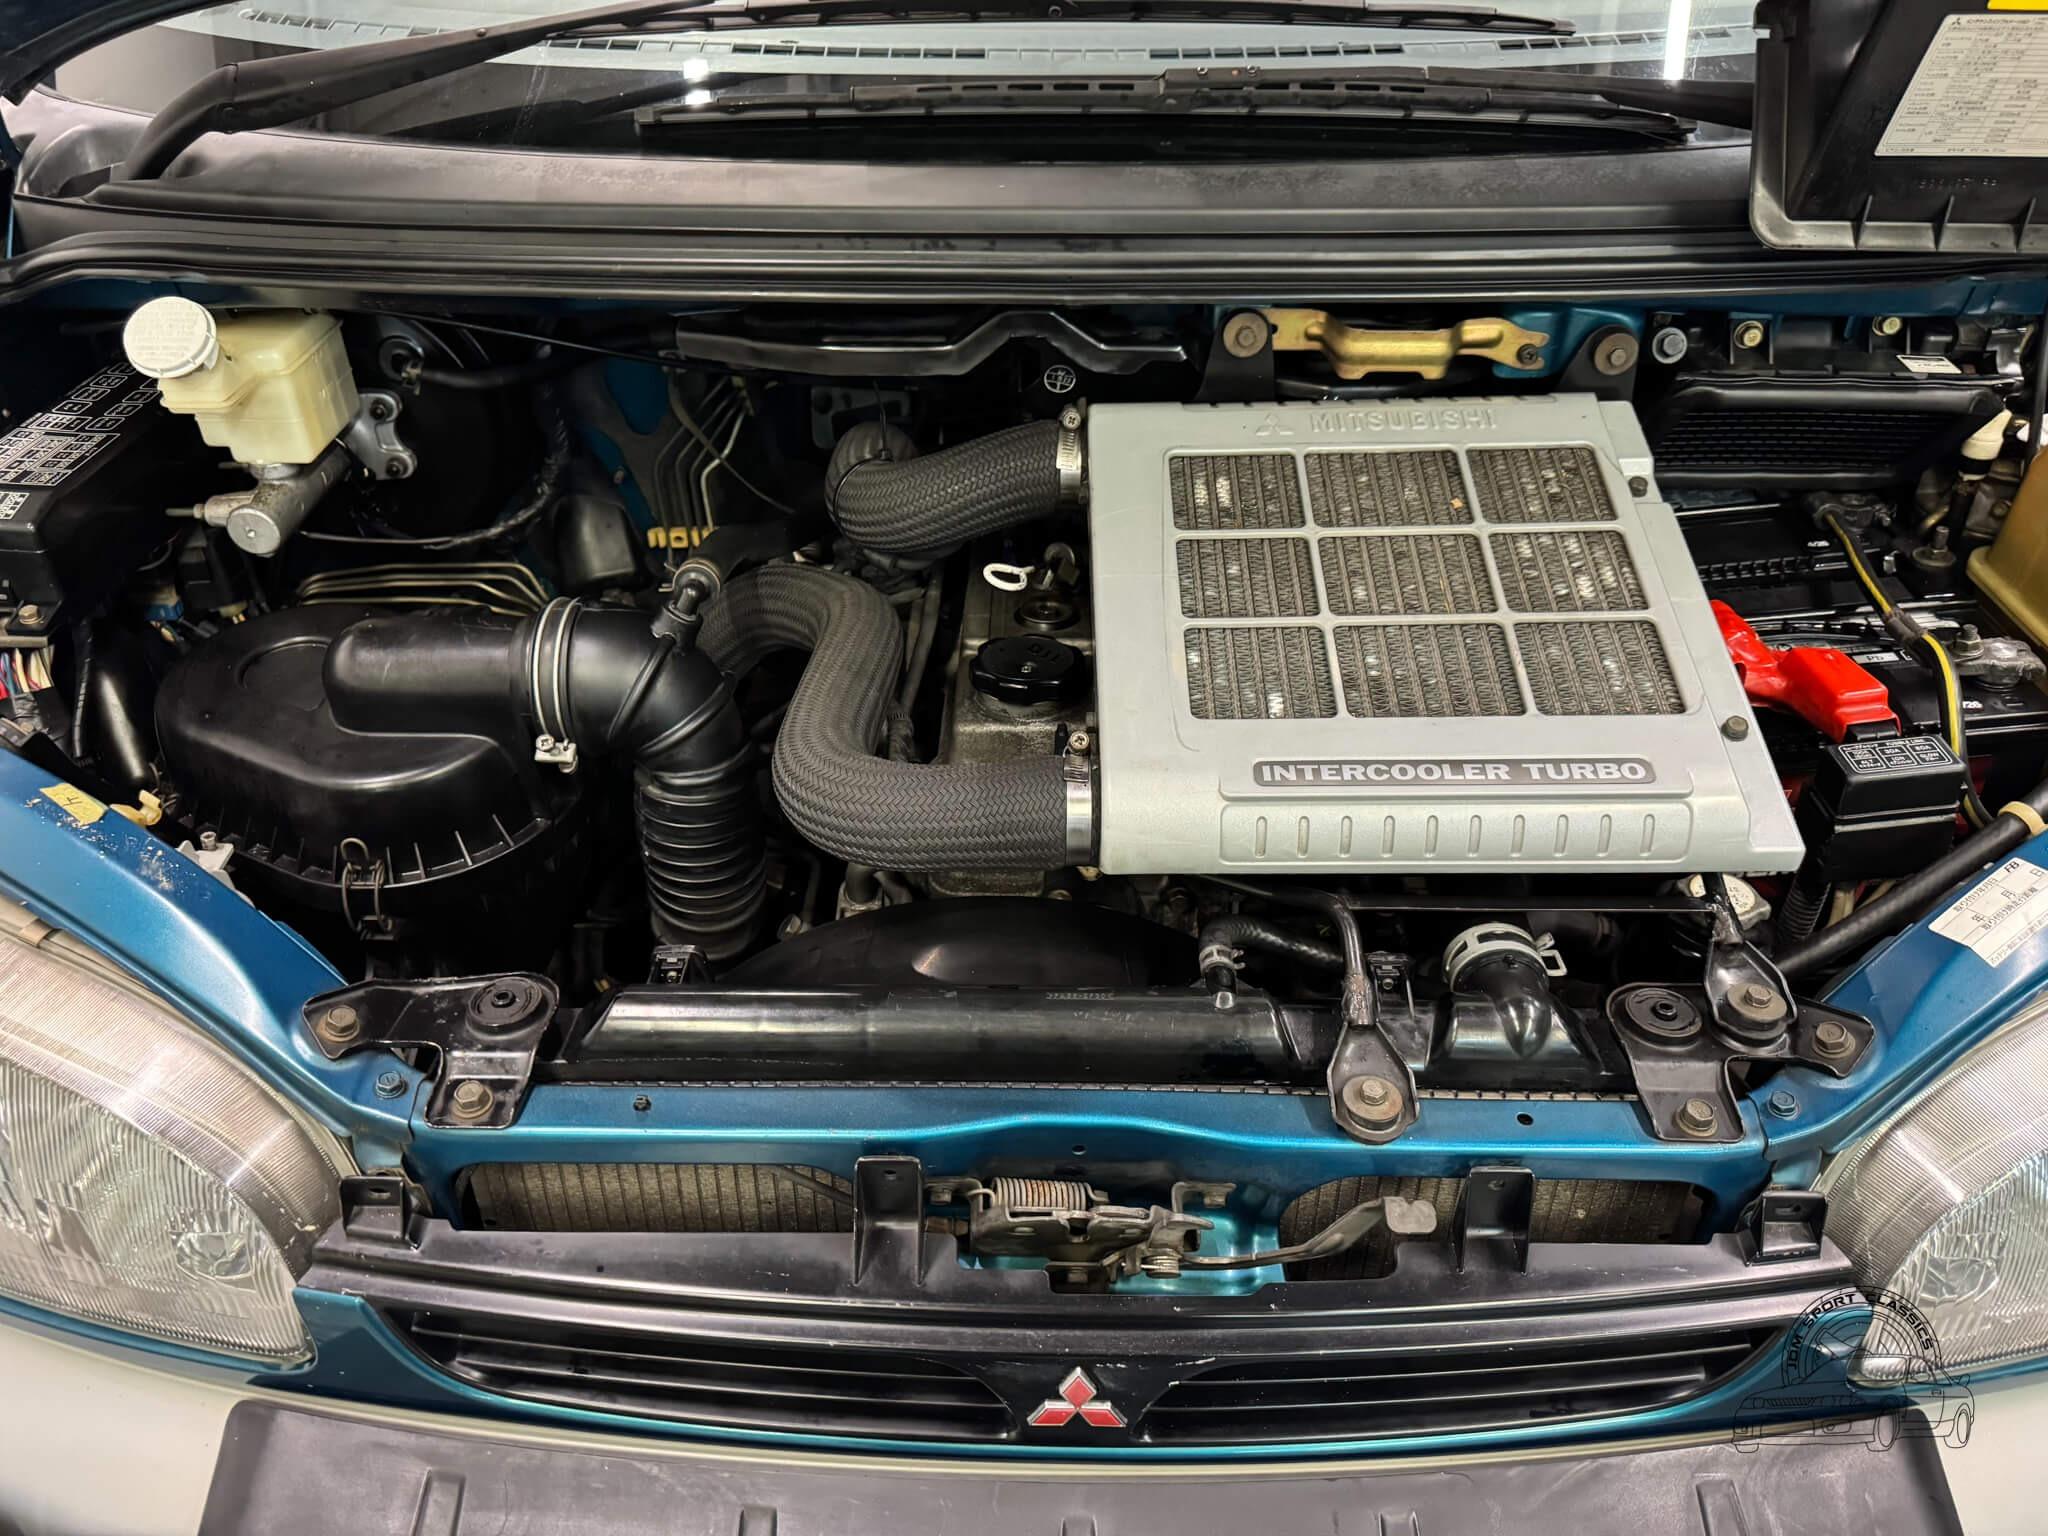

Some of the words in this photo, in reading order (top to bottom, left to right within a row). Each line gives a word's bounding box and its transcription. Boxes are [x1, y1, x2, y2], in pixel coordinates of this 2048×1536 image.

[1309, 408, 1497, 432] MITSUBISHI
[1261, 763, 1511, 782] INTERCOOLER
[1522, 762, 1647, 781] TURBO
